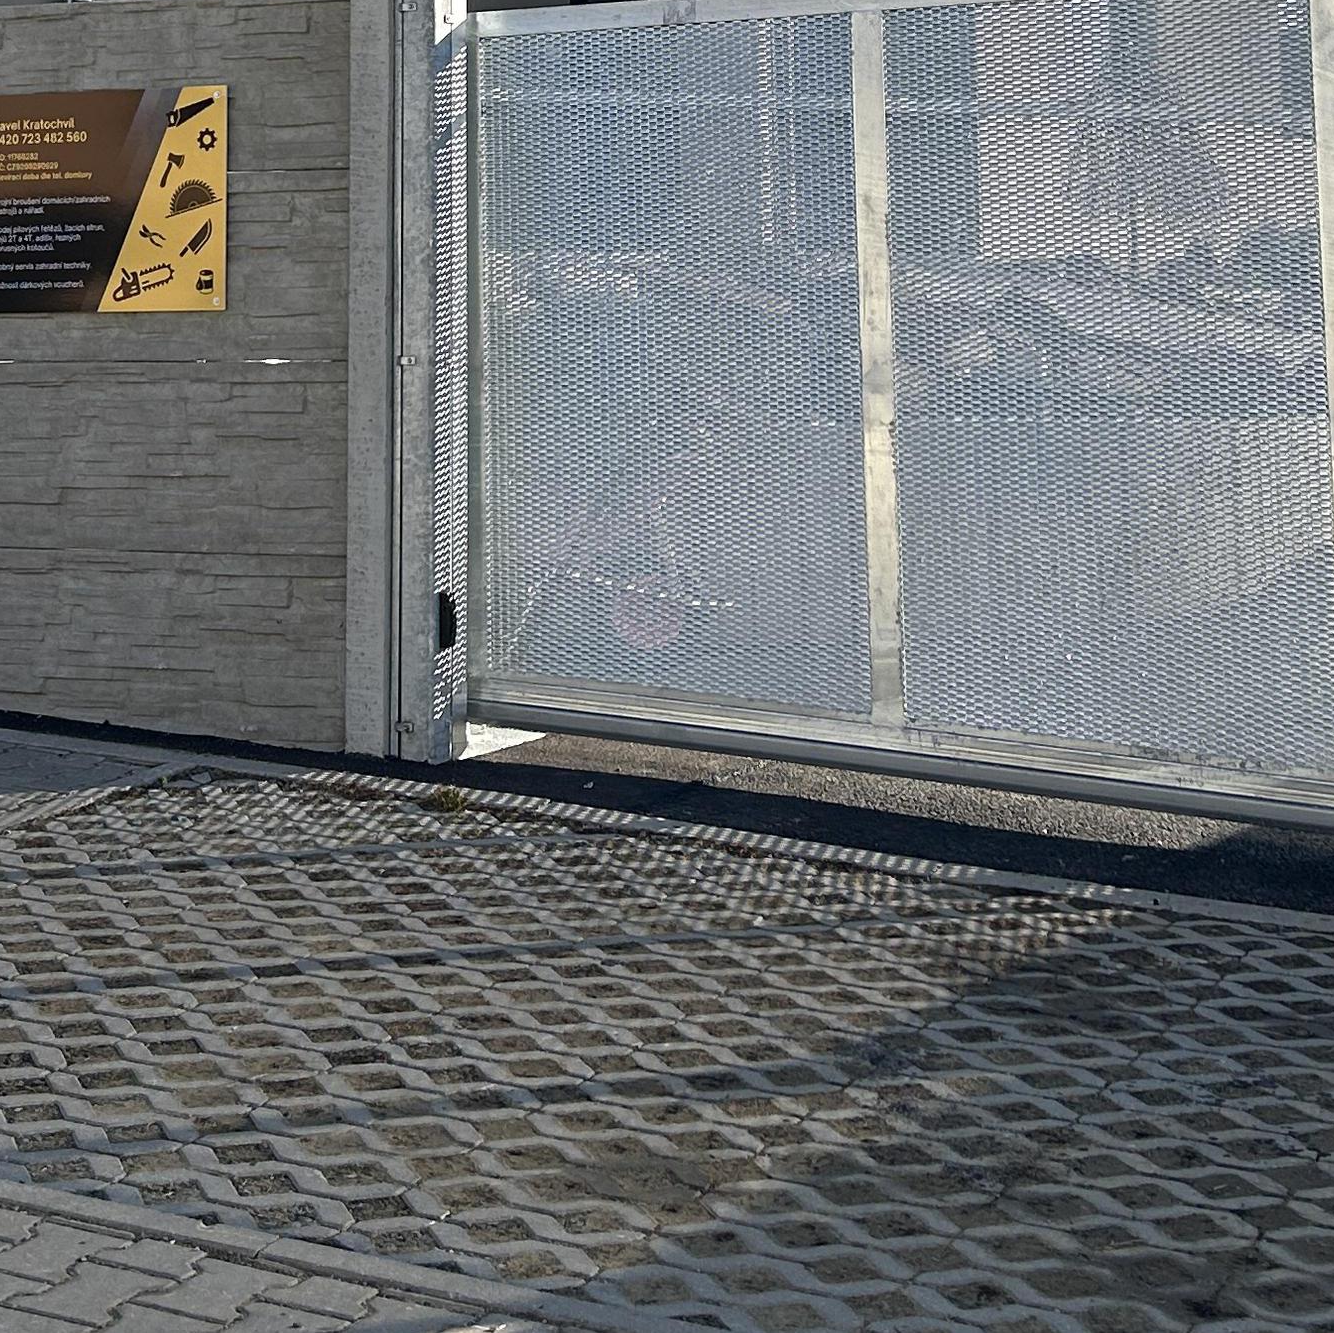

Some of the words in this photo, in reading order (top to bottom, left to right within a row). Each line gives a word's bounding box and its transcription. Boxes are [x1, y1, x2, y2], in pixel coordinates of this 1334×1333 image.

[23, 117, 75, 130] Kratochvíl
[21, 133, 41, 144] 723
[43, 132, 64, 143] 482
[66, 131, 87, 142] 560
